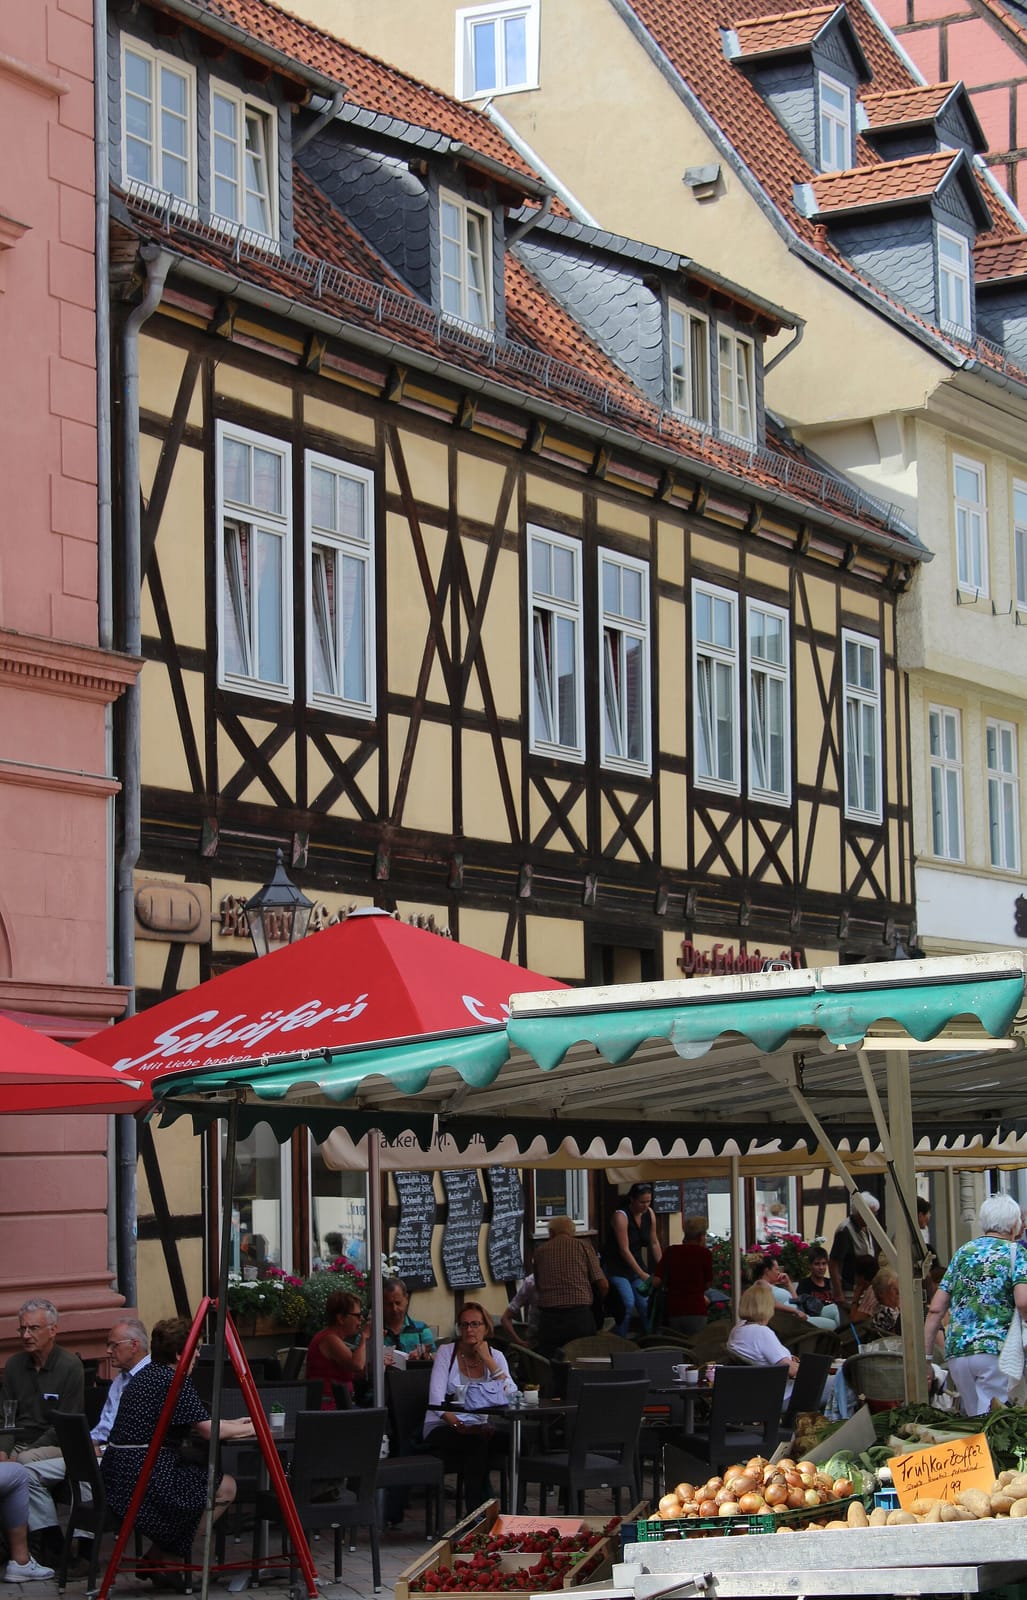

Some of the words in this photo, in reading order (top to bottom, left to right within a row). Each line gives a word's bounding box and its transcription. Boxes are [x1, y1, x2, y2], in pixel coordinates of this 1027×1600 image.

[680, 939, 712, 974] Das
[112, 993, 368, 1072] Schäfer's
[138, 1062, 162, 1072] Mit
[165, 1058, 201, 1070] Liebe
